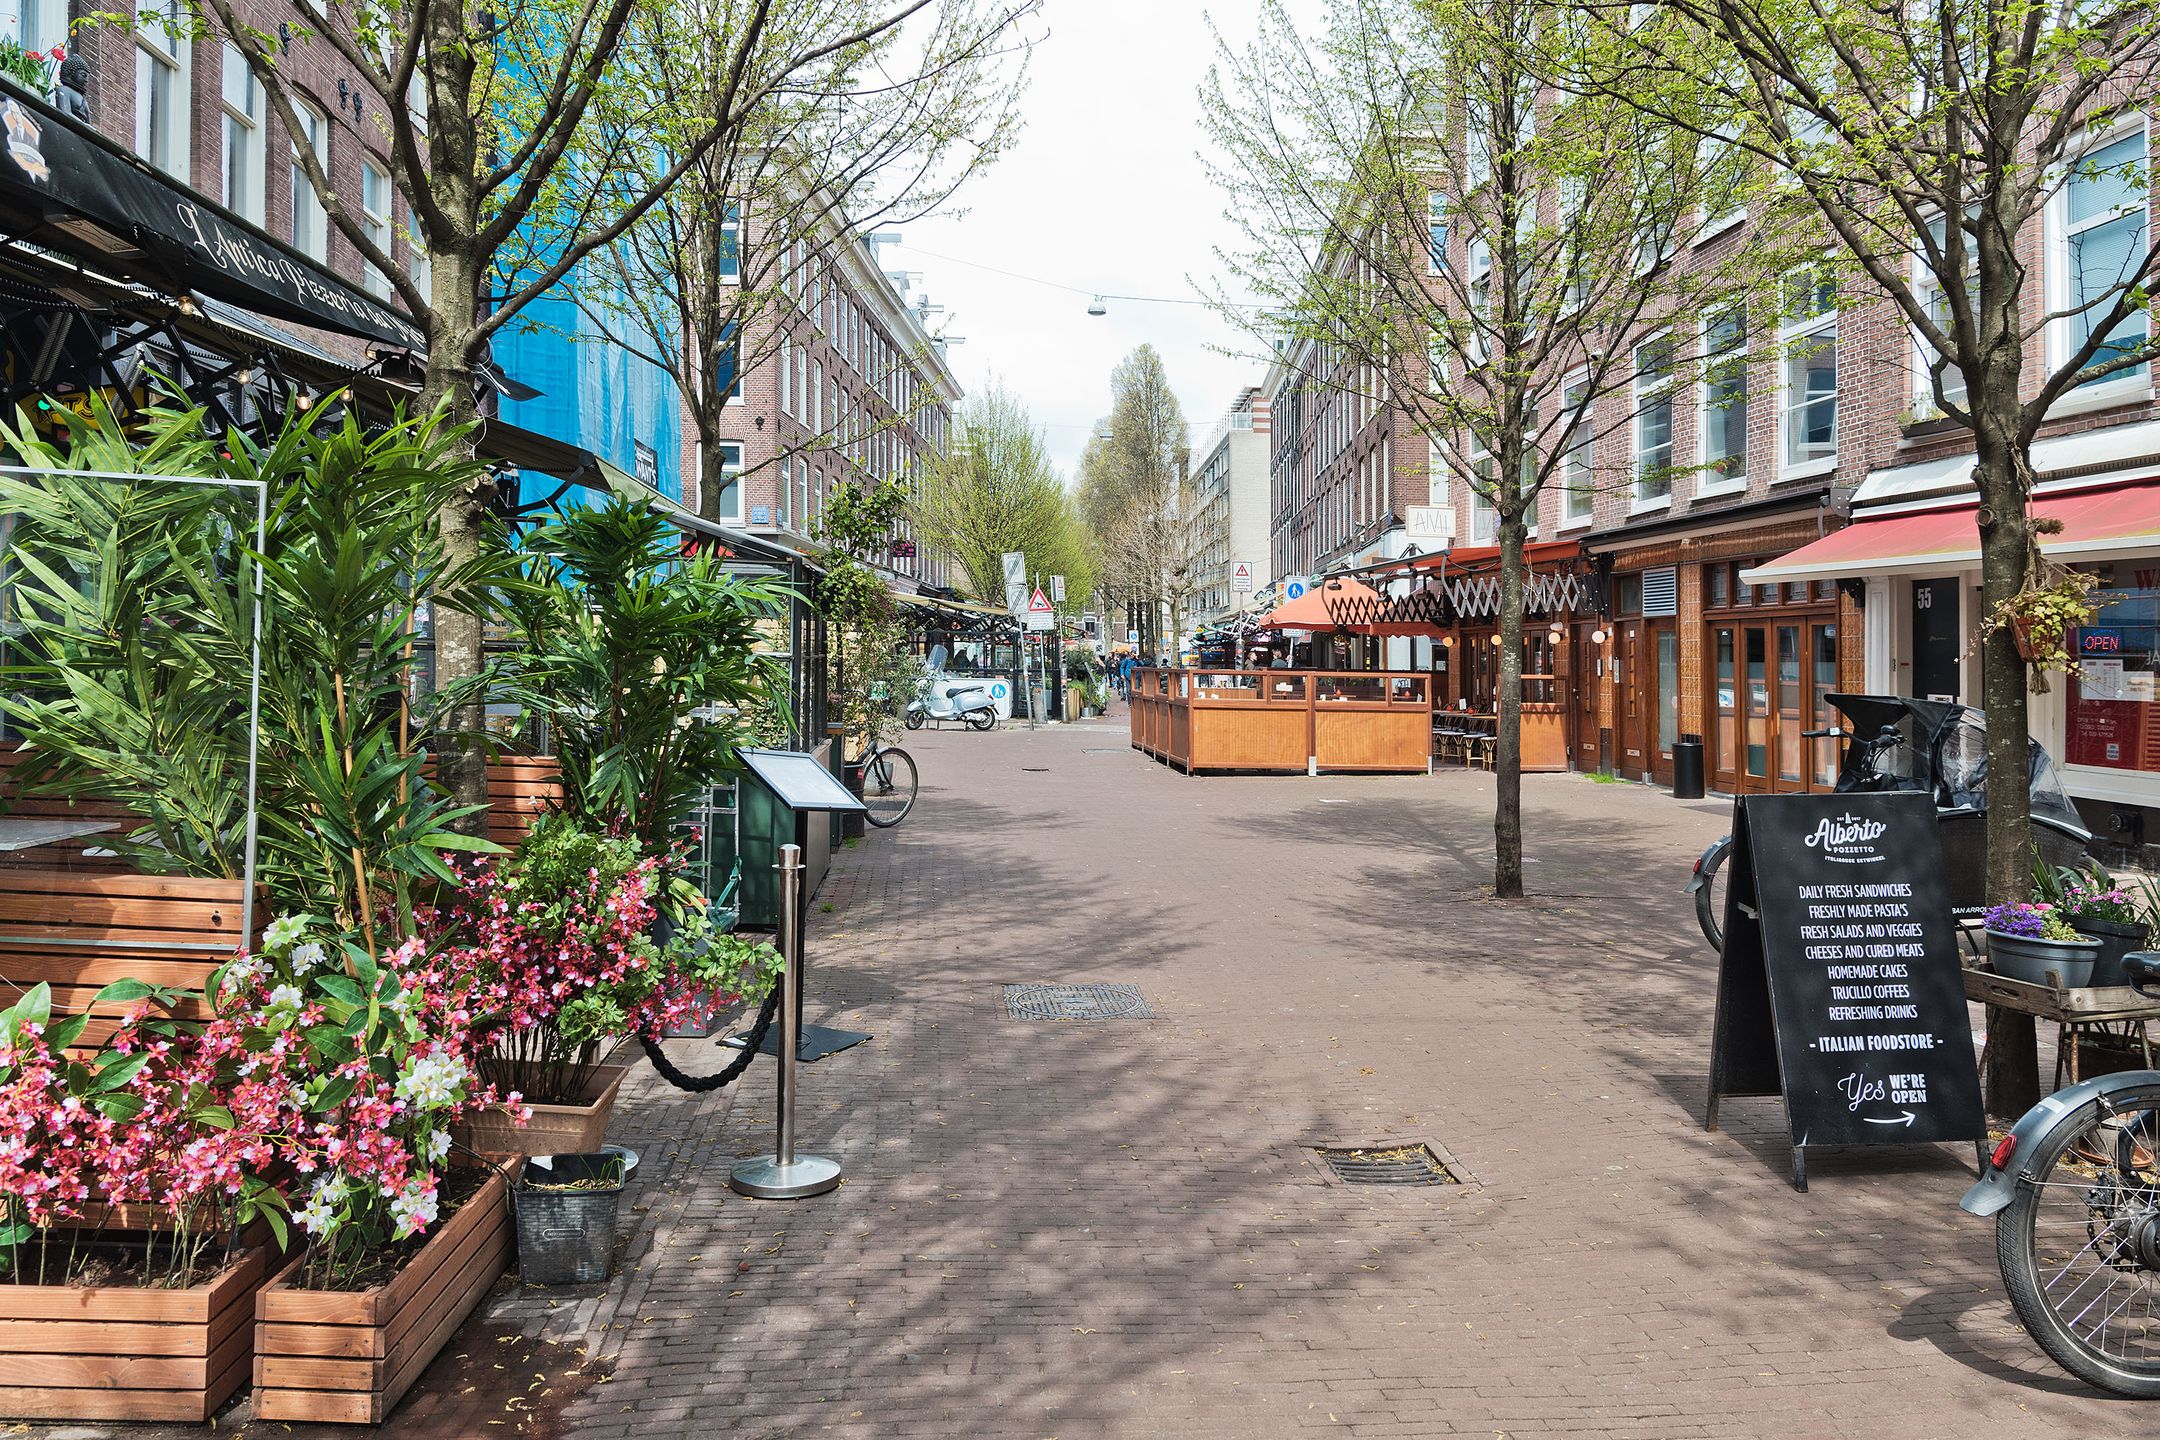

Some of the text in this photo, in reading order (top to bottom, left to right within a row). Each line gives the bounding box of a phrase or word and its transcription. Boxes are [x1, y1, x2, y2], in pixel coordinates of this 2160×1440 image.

[279, 258, 370, 322] Pizzeria
[1917, 587, 1932, 609] 55
[2085, 635, 2119, 651] OPEN
[1804, 817, 1887, 852] Alberto
[1833, 846, 1875, 854] POZZETTO
[1799, 883, 1912, 899] DAILY FRESH SANDWICHES
[1808, 903, 1909, 919] FRESHLY MADE PASTA'S
[1800, 923, 1923, 939] FRESH SALADS AND VEGGIES
[1805, 943, 1925, 960] CHEESES AND CURED MEATS
[1827, 964, 1908, 980] HOMEMADE CAKES
[1831, 984, 1910, 1000] TRUCILLO COFFEES
[1828, 1004, 1918, 1021] REFRESHING DRINKS
[1818, 1034, 1934, 1052] ITALIAN FOODSTORE
[1837, 1072, 1927, 1112] Yes WE'RE
[1891, 1089, 1927, 1104] OPEN
